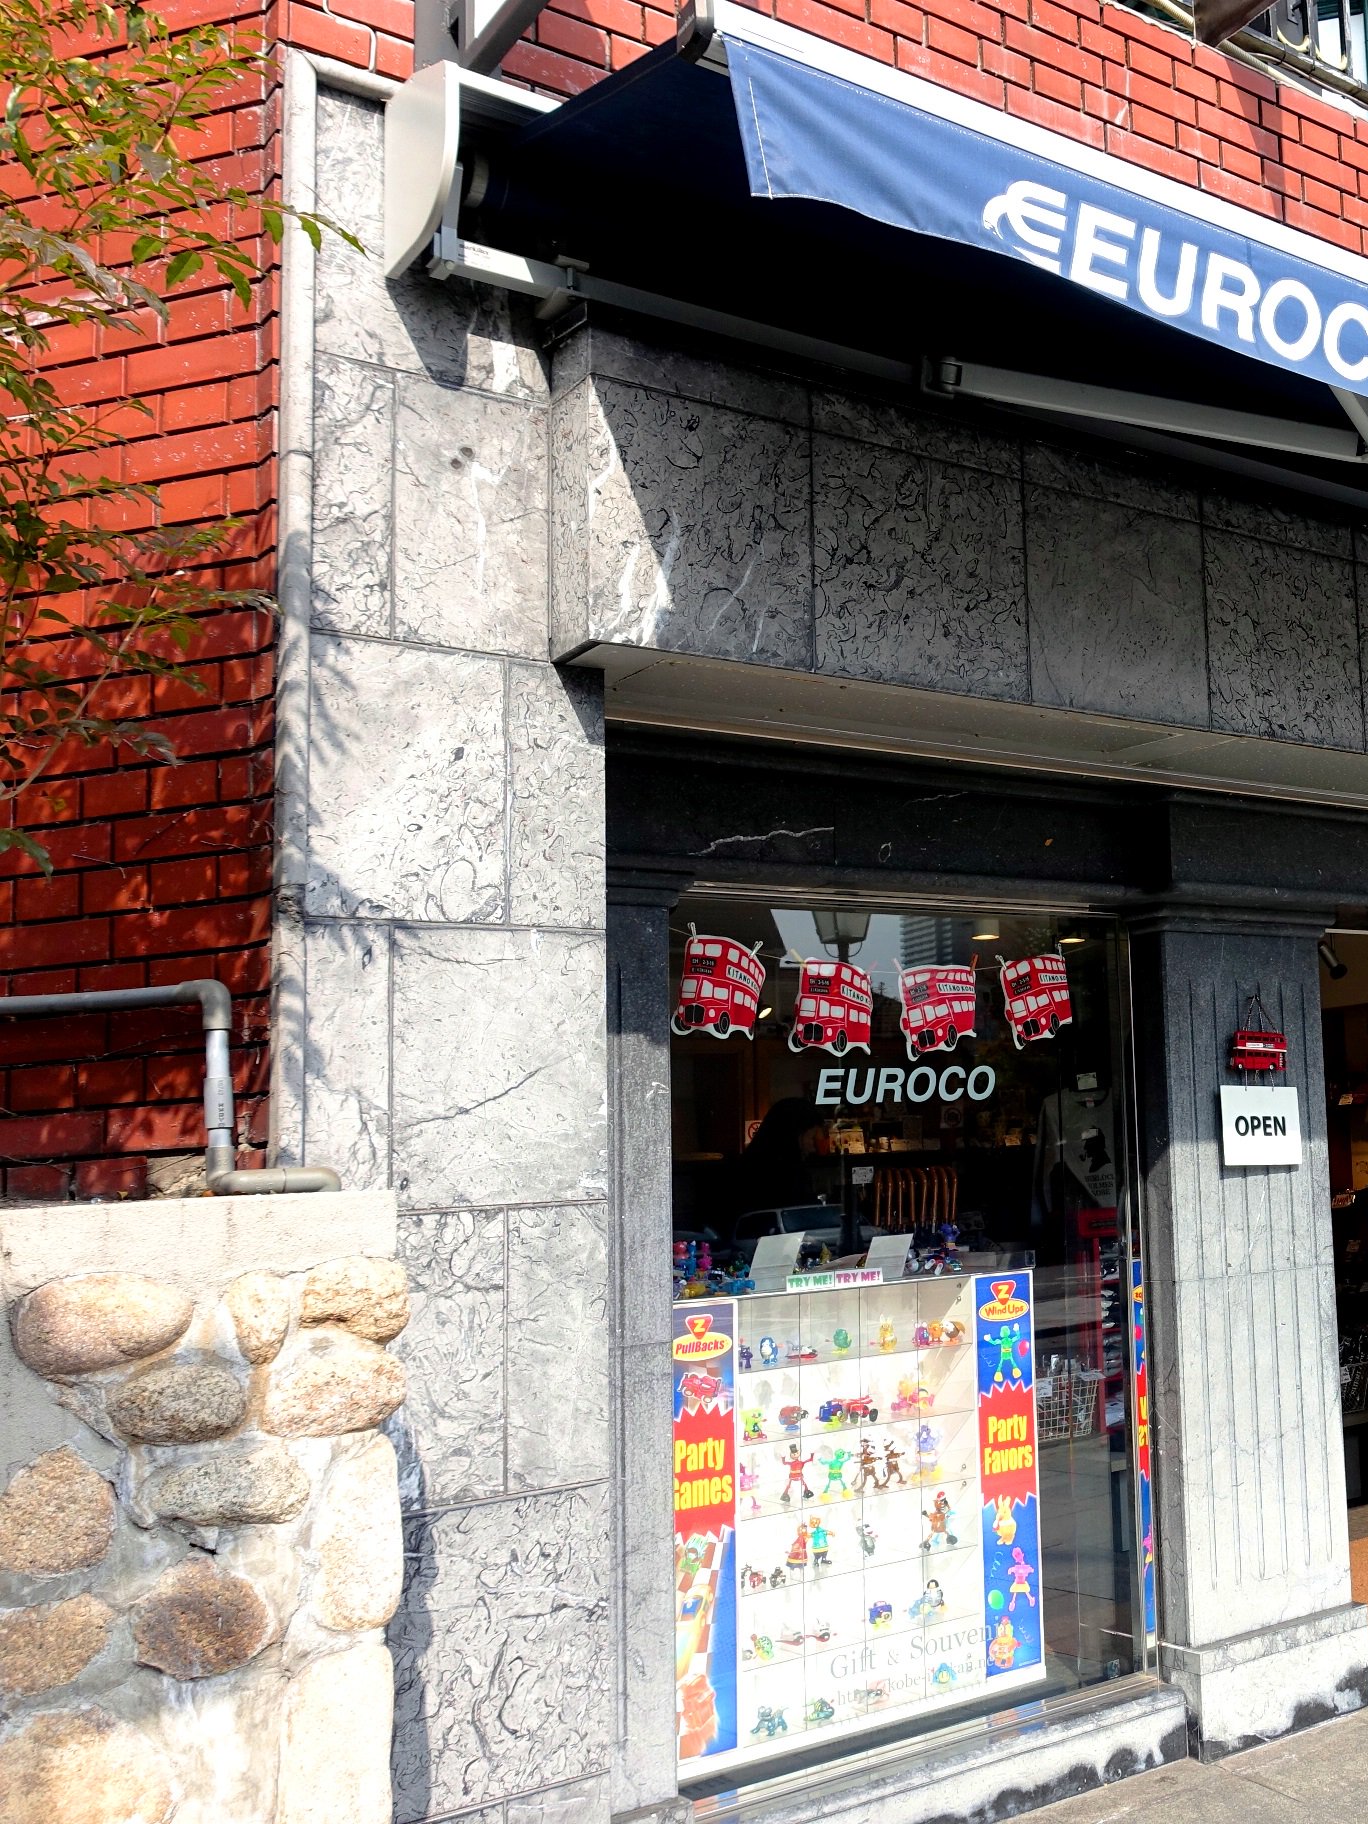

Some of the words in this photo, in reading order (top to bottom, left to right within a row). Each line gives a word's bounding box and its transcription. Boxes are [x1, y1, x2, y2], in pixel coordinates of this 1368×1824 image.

[815, 1065, 996, 1106] EUROCO
[1235, 1115, 1287, 1137] OPEN
[788, 1276, 812, 1289] TRY
[813, 1272, 833, 1286] ME!
[836, 1273, 859, 1285] TRY
[861, 1271, 881, 1283] ME!
[998, 1285, 1010, 1299] Z
[693, 1319, 706, 1333] Z
[988, 1414, 1027, 1444] Party
[675, 1439, 725, 1473] Party
[984, 1445, 1033, 1475] Favors
[830, 1648, 876, 1679] Gift
[888, 1652, 900, 1666] &
